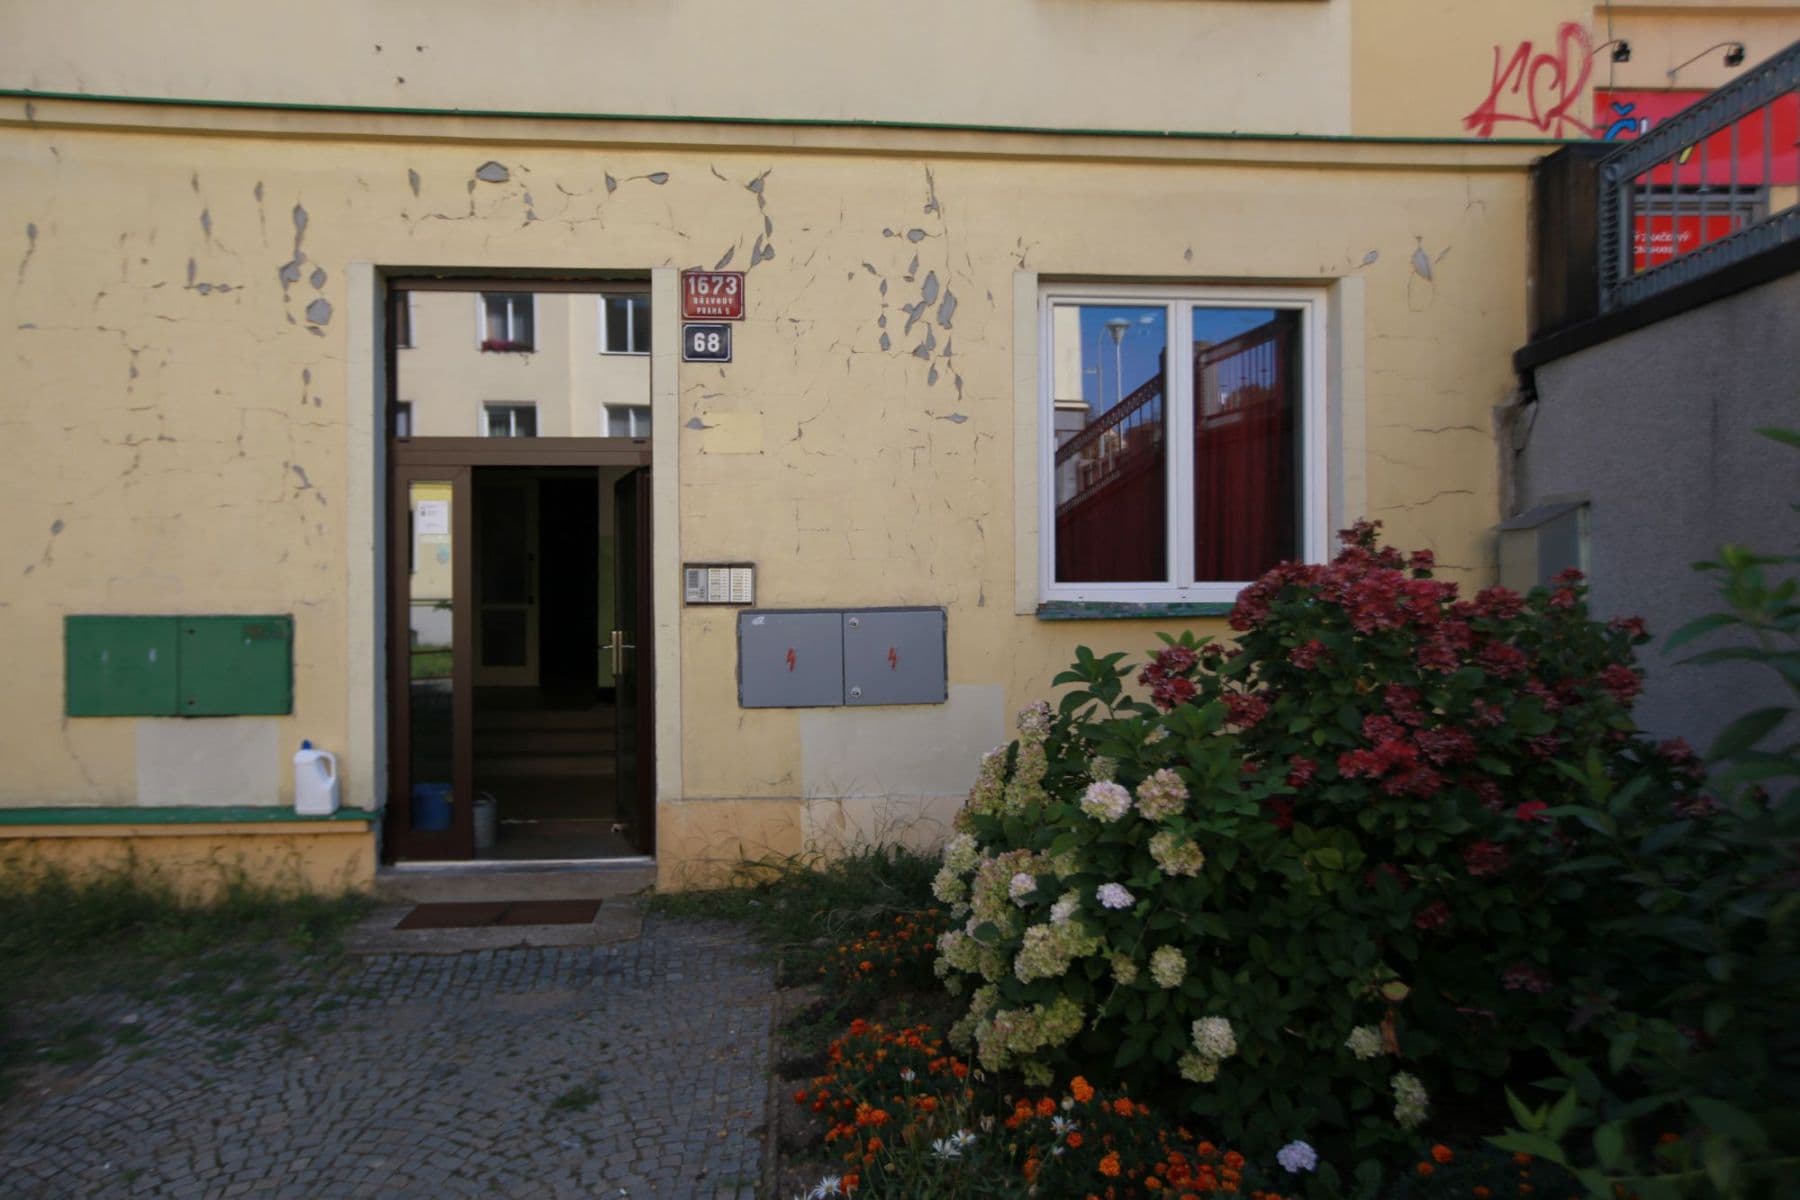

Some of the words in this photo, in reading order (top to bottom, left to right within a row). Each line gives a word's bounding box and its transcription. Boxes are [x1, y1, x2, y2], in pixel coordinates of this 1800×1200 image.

[689, 276, 738, 295] 1673
[696, 307, 723, 315] PRAHA
[694, 332, 720, 352] 68
